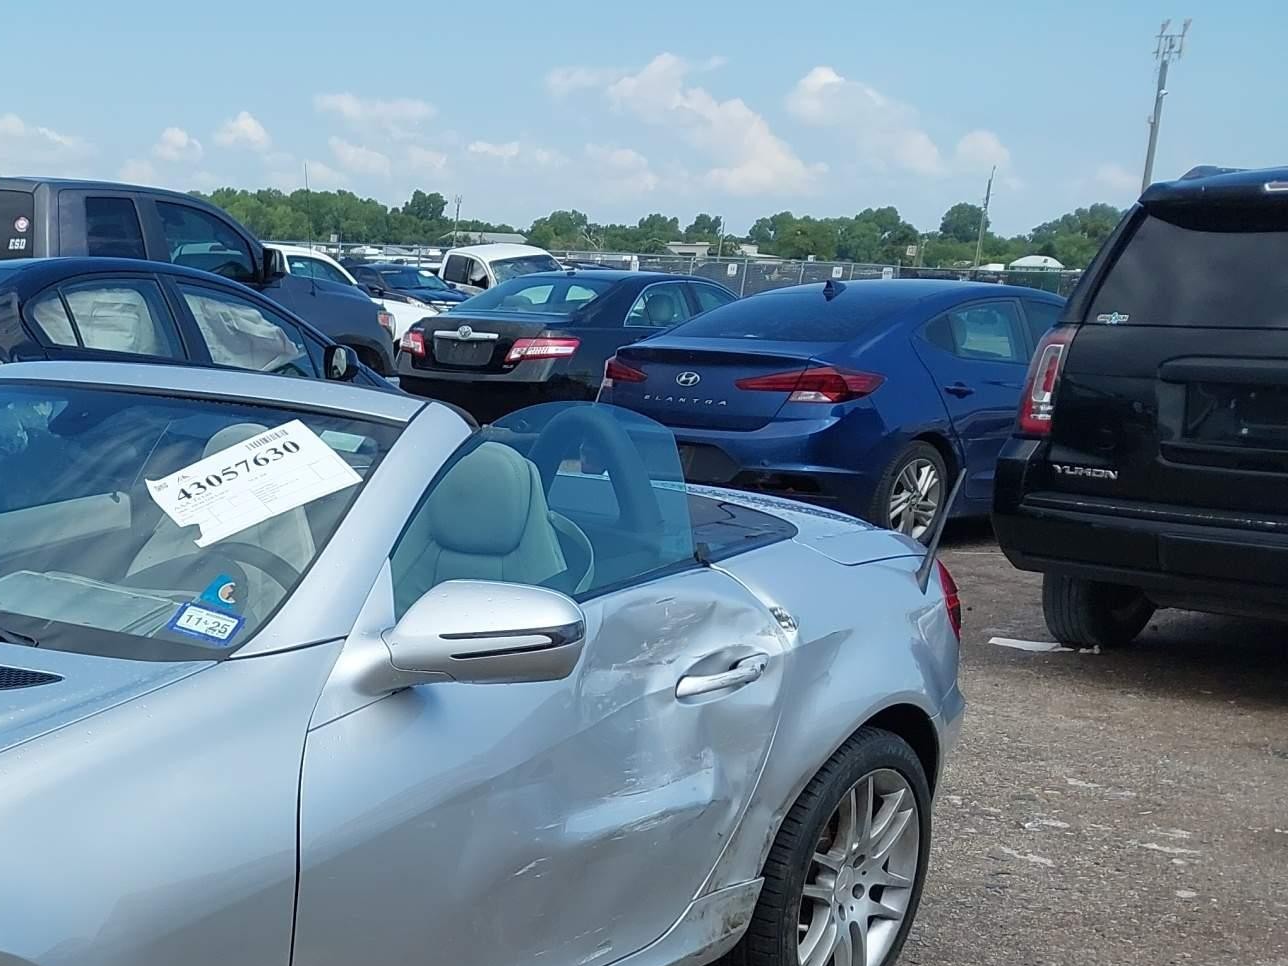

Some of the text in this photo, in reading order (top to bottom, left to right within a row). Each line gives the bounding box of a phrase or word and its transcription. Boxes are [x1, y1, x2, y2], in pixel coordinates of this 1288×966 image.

[644, 394, 727, 406] ELANTRA
[177, 440, 300, 501] 43057630
[1052, 464, 1118, 480] YUKON
